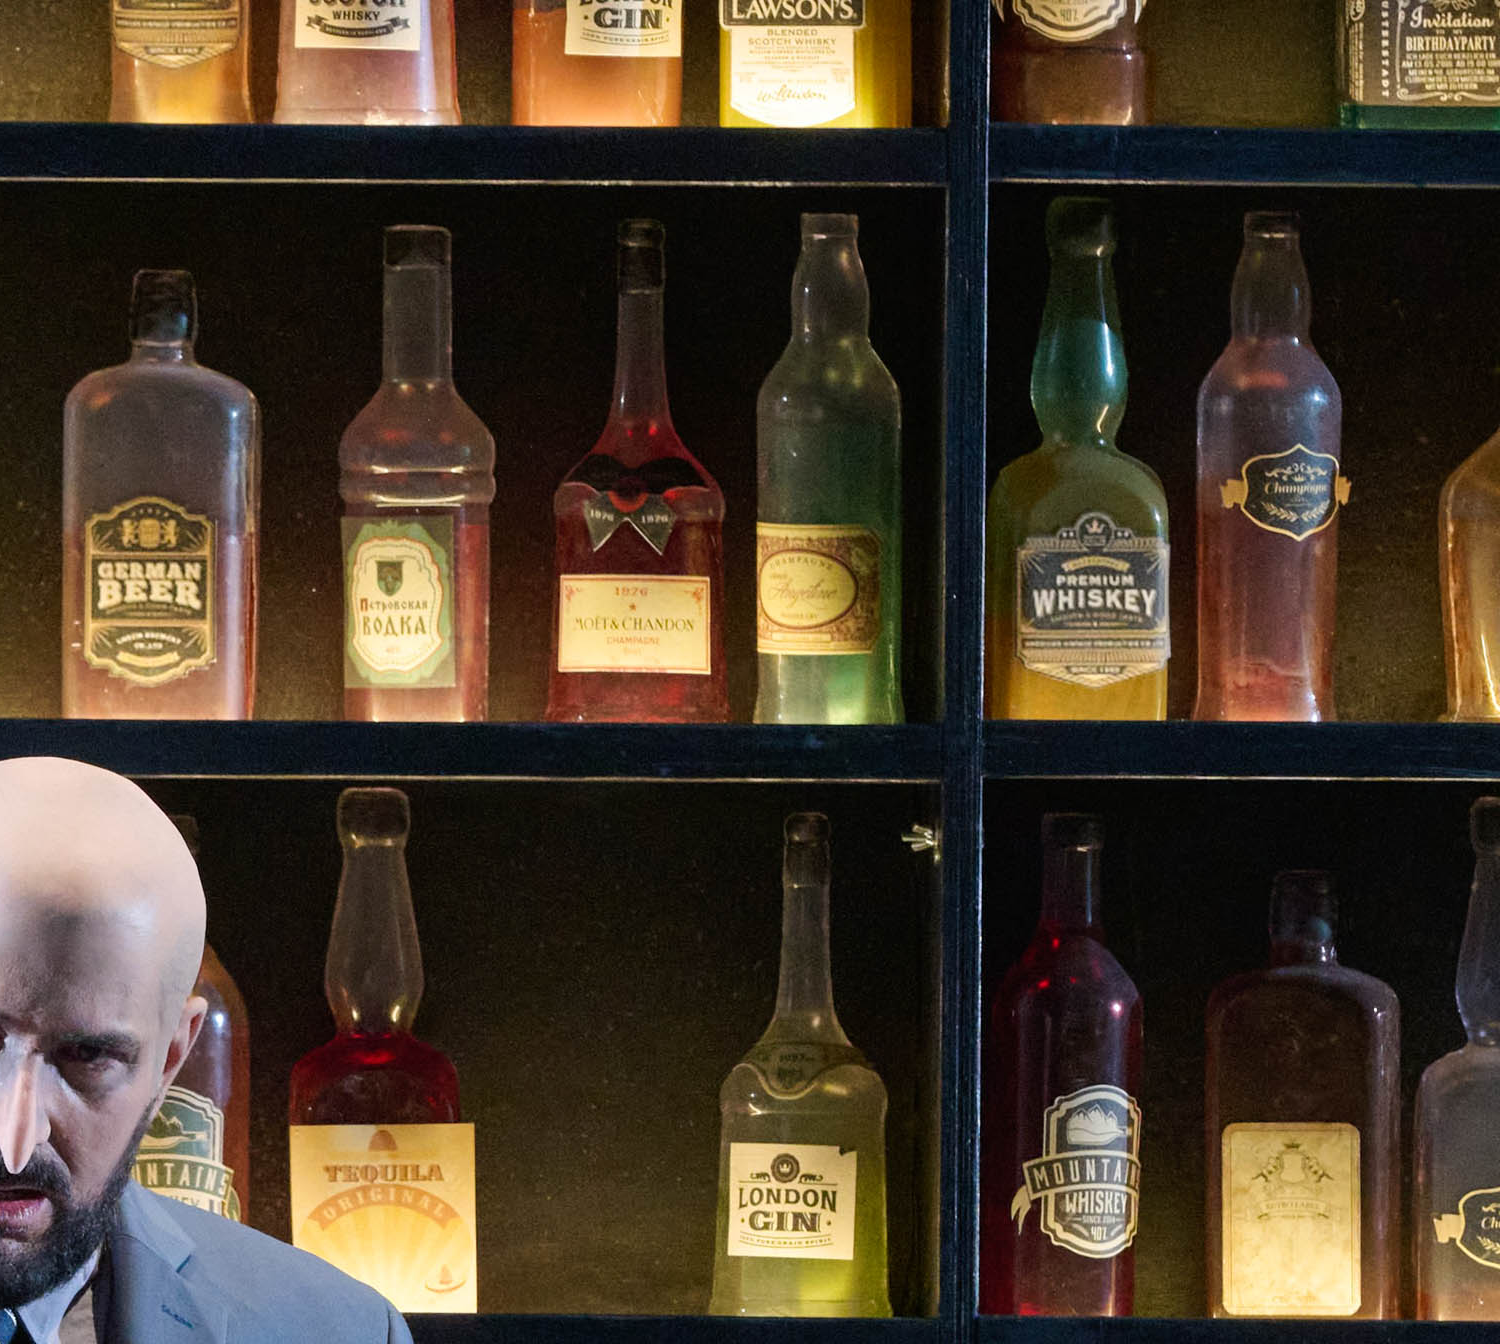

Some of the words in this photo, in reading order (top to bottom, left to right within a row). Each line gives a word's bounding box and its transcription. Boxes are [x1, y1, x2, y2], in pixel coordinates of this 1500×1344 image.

[332, 10, 380, 21] WHISKY
[593, 8, 662, 29] GIN
[732, 0, 854, 19] LAWSON'S
[1409, 5, 1494, 28] Invitation
[1405, 36, 1496, 51] BIRTHDAYPARTY
[97, 561, 202, 580] GERMAN
[1056, 574, 1135, 587] PREMIUM
[97, 580, 202, 610] BEER
[1033, 589, 1157, 617] WHISKEY
[362, 616, 427, 637] ВОДКА
[622, 617, 695, 632] CHANDON
[136, 1162, 229, 1196] NTAINS
[323, 1164, 444, 1184] TEQUILA
[1032, 1158, 1139, 1190] MOUNTAIN
[323, 1186, 445, 1221] ORIGINAL
[738, 1187, 838, 1213] LONDON
[1065, 1190, 1128, 1214] WHISKEY
[749, 1210, 821, 1233] GIN
